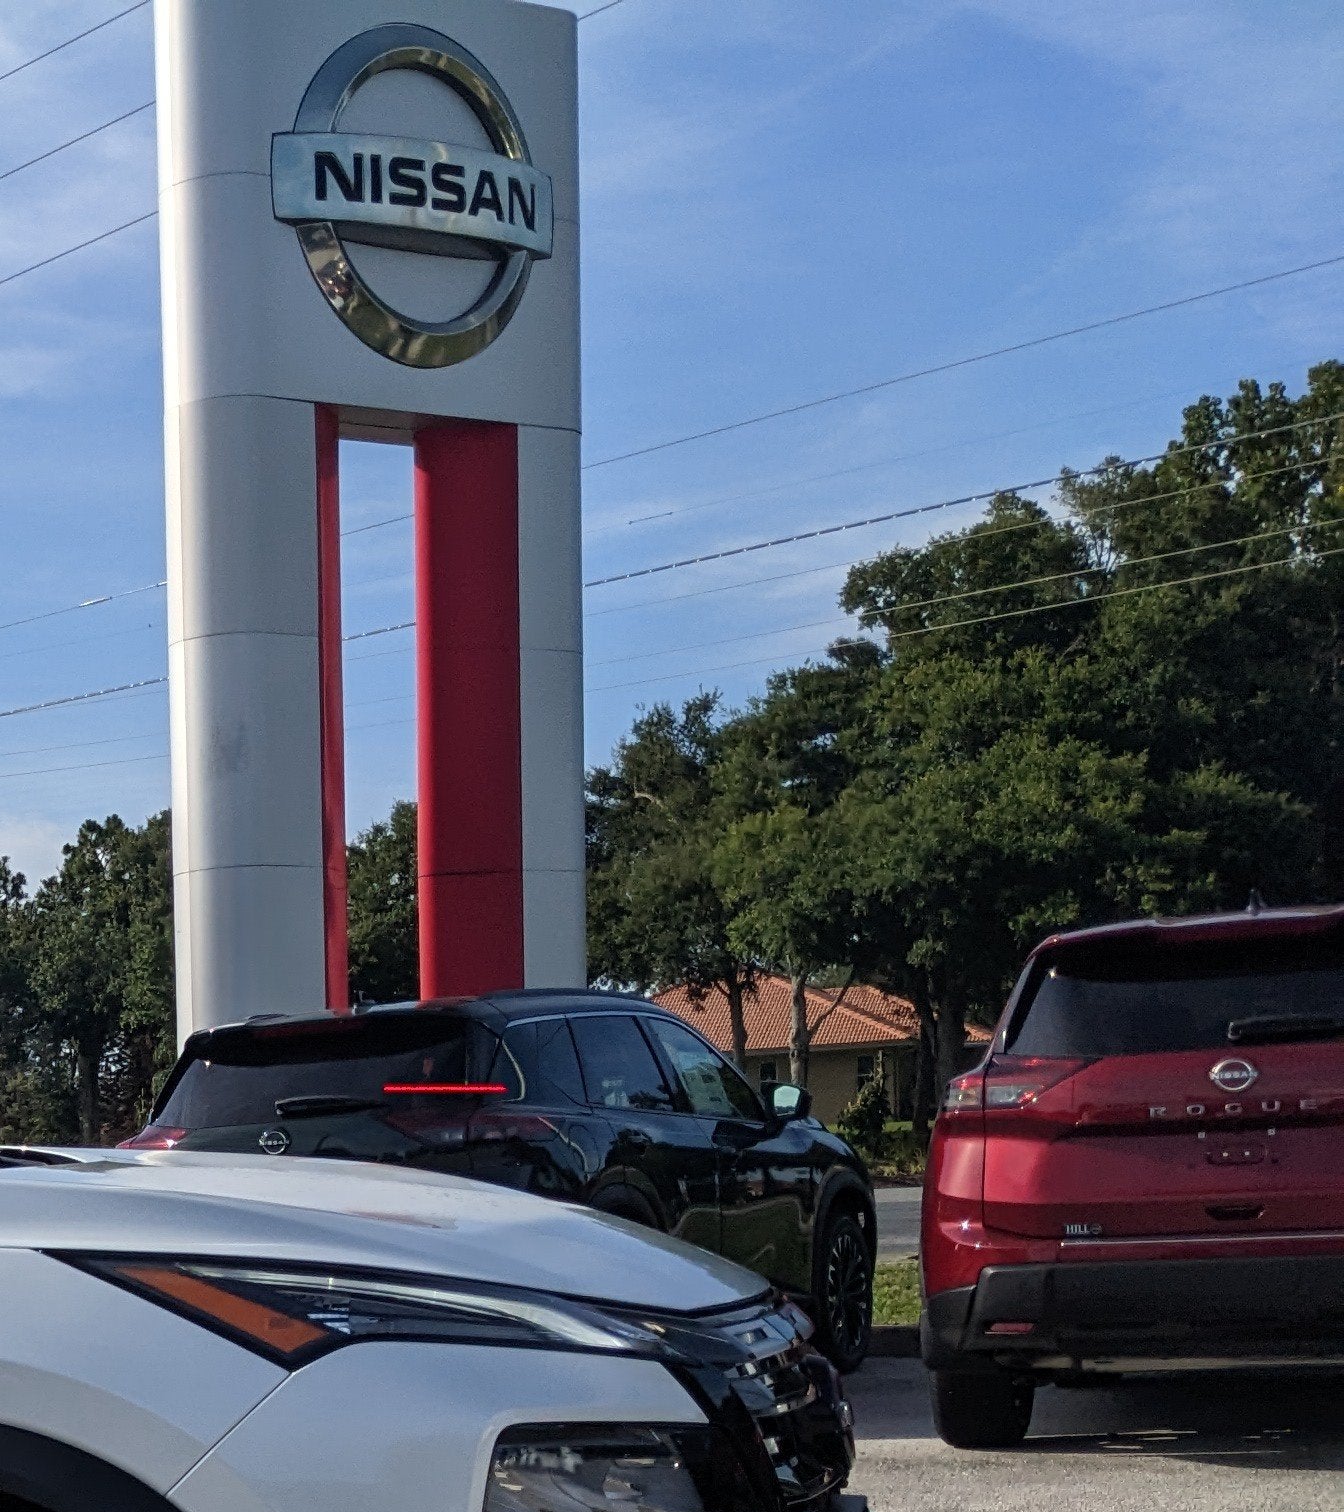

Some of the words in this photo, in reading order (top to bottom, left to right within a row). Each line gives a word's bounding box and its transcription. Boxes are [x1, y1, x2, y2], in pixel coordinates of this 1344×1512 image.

[314, 151, 536, 232] NISSAN
[1209, 1071, 1258, 1080] NISSAN
[1149, 1099, 1317, 1118] ROGUE
